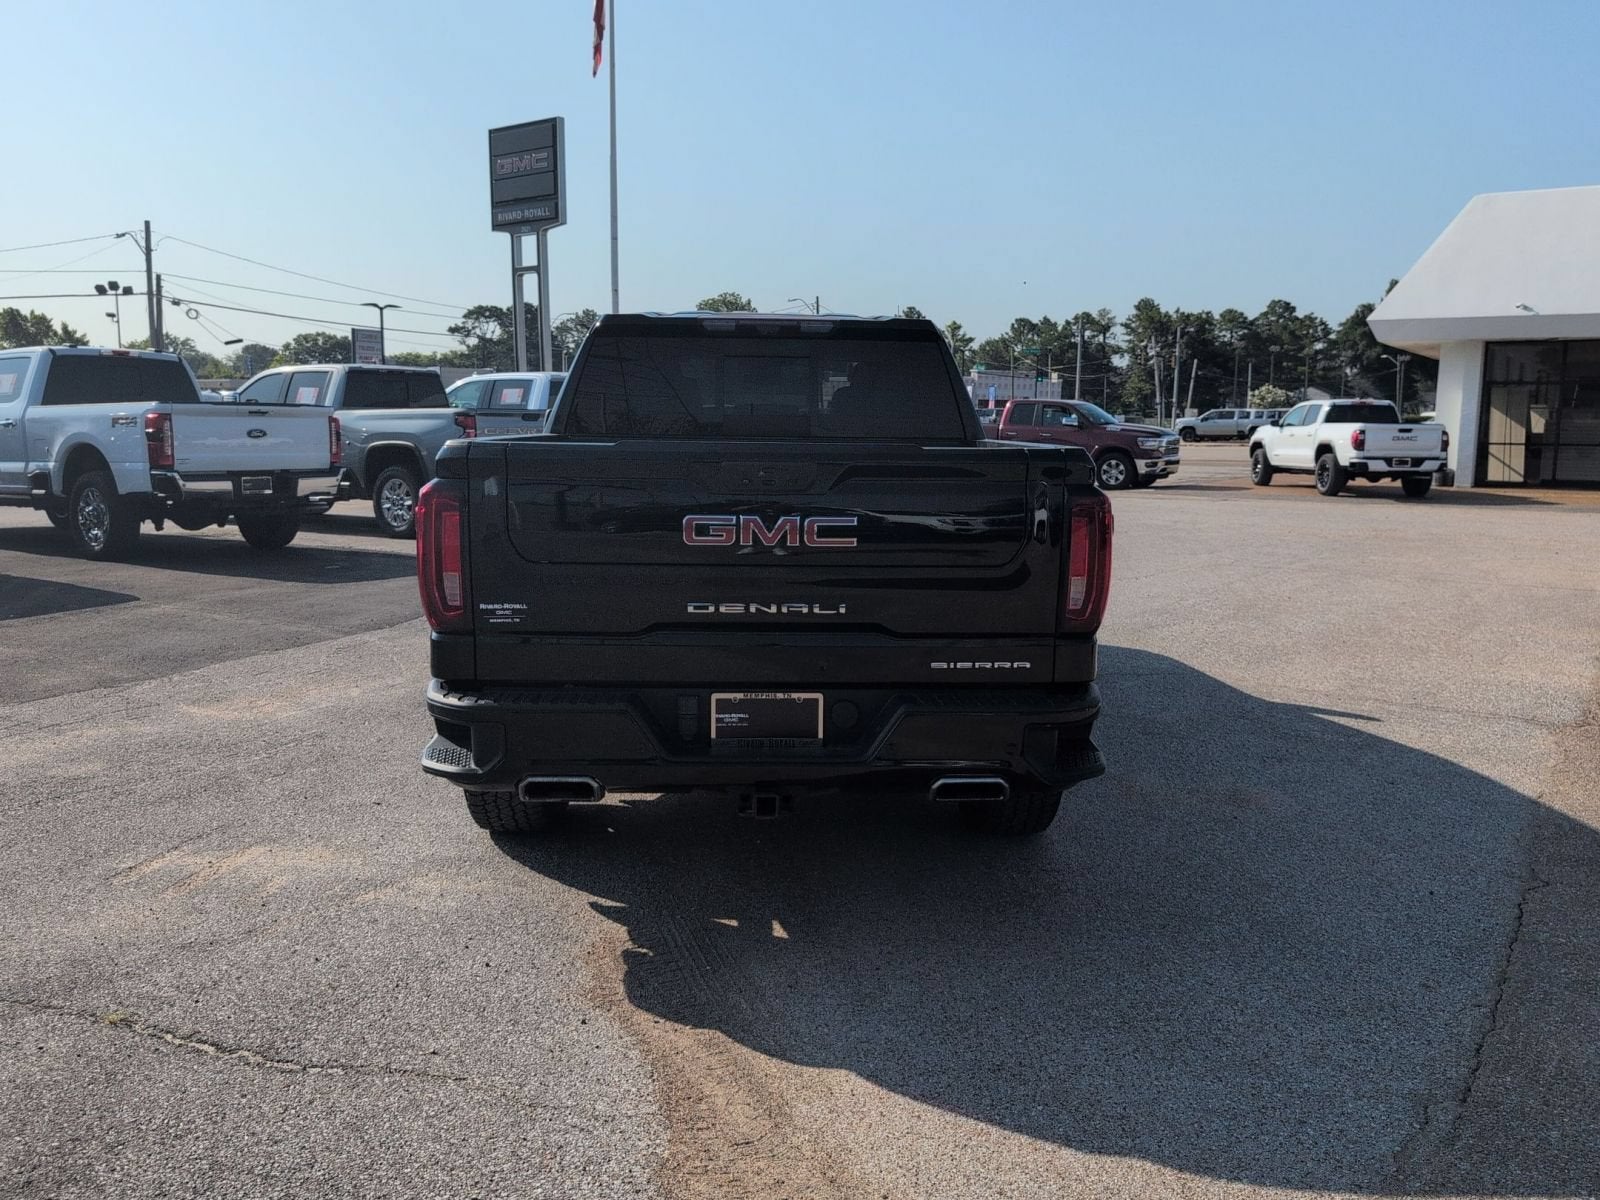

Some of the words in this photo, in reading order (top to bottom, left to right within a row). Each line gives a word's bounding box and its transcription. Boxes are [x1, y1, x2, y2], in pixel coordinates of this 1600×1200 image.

[496, 152, 548, 174] GMC
[497, 207, 550, 222] RIVARD-ROYALL
[682, 515, 858, 547] GMC
[687, 602, 847, 614] DENALI
